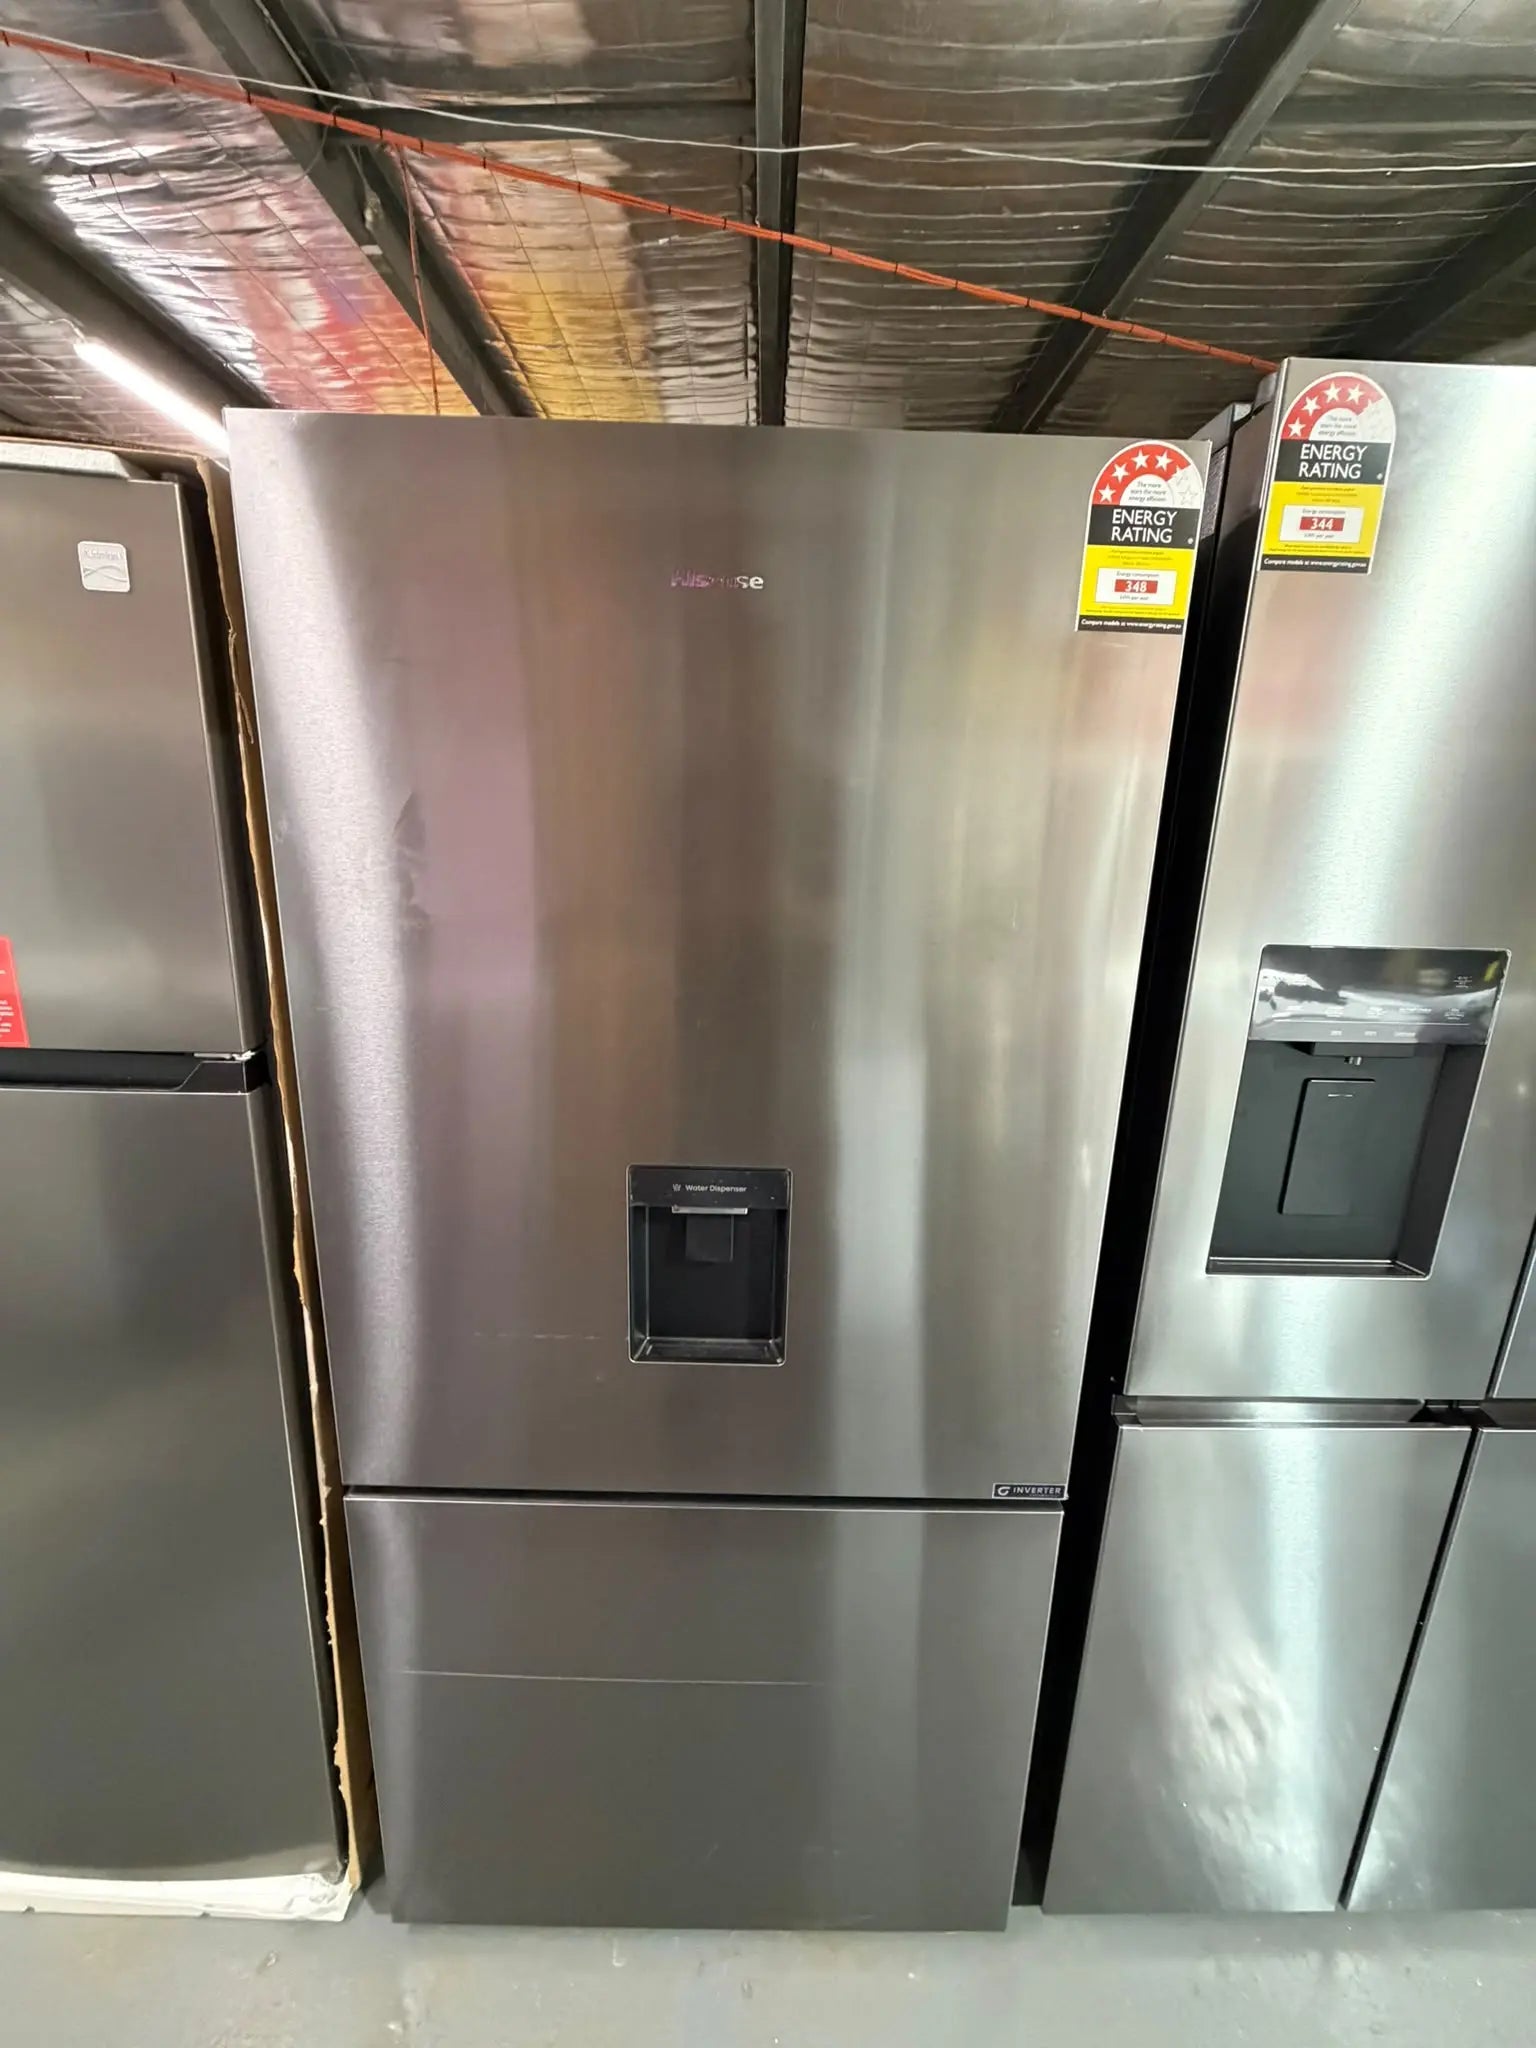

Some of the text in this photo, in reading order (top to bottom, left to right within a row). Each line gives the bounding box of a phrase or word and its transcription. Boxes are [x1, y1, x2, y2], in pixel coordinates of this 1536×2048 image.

[1300, 443, 1368, 461] ENERGY
[1298, 461, 1362, 479] RATING
[1112, 508, 1178, 526] ENERGY
[1310, 517, 1334, 530] 344
[1111, 526, 1173, 543] RATING
[1263, 558, 1286, 566] Compare
[1124, 580, 1148, 592] 348
[1081, 619, 1103, 627] Compare
[685, 1184, 747, 1193] Water Dispenser
[1013, 1486, 1062, 1495] INVERTER
